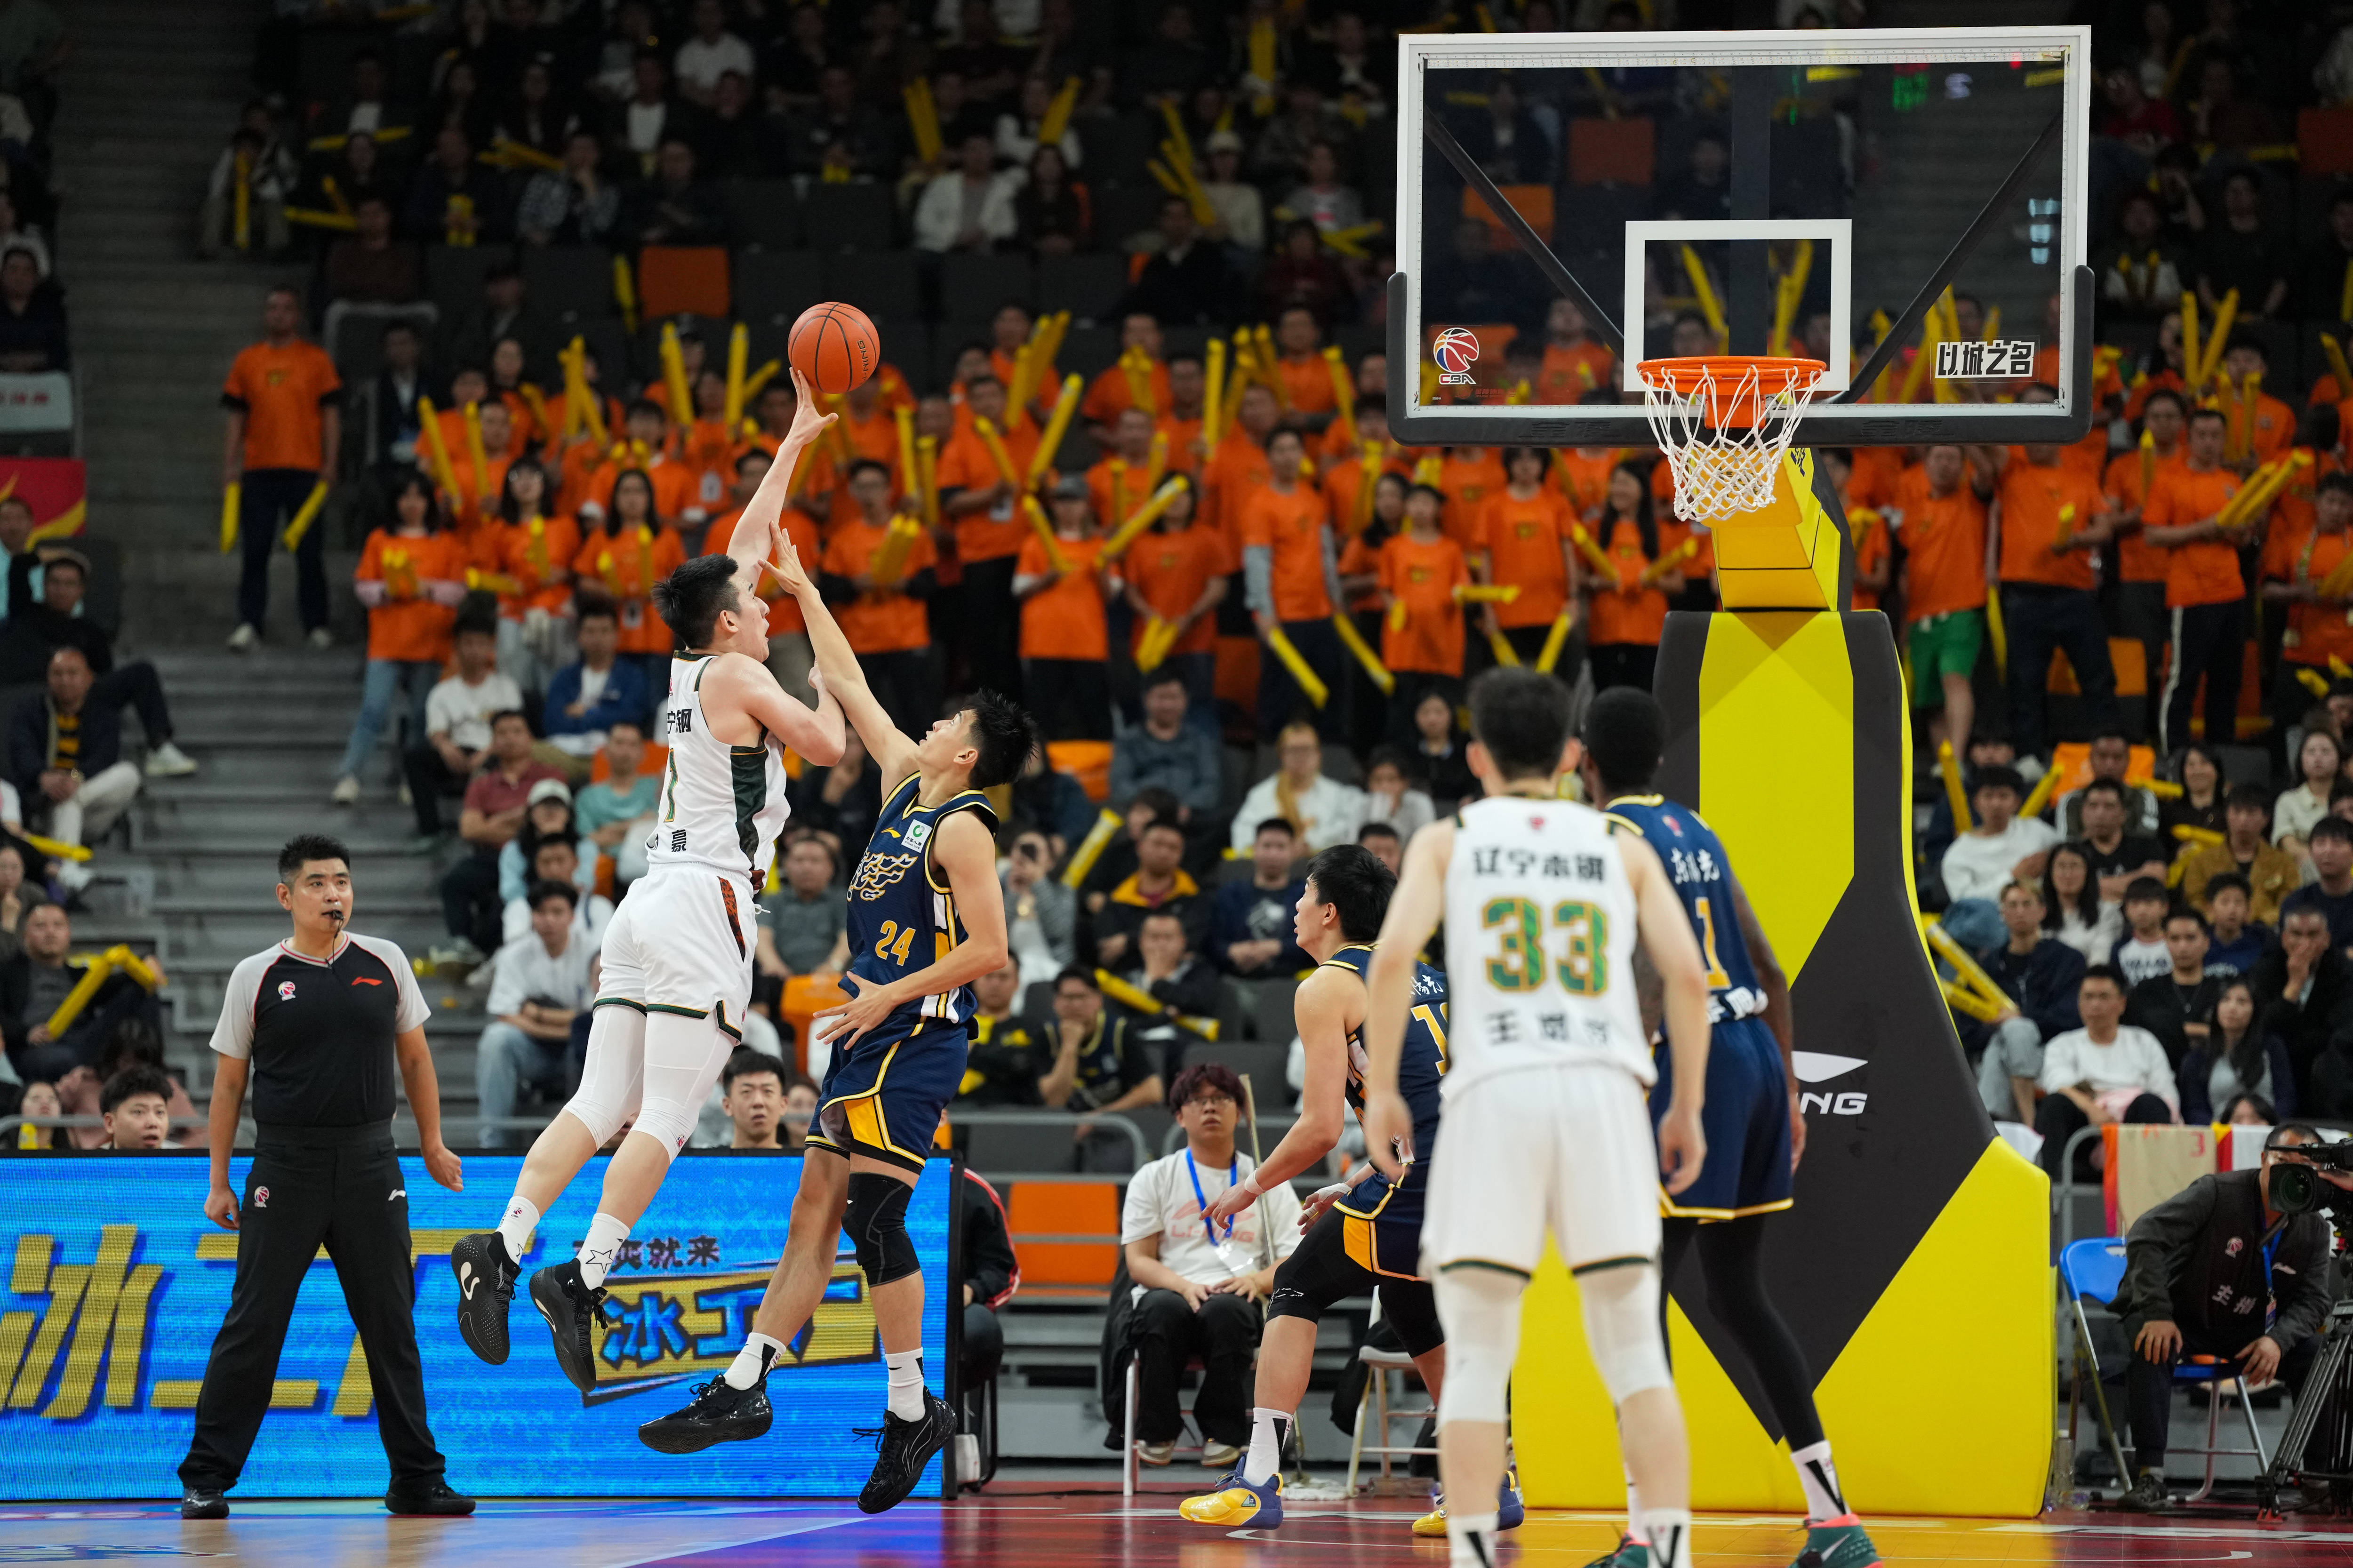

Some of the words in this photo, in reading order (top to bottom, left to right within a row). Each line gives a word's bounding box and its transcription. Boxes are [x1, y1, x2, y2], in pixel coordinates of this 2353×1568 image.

[857, 340, 869, 380] I-NING
[1937, 342, 2033, 376] 以城之名
[1439, 374, 1476, 384] CBA
[667, 708, 692, 734] 宁钢
[663, 747, 678, 823] 1
[906, 836, 922, 847] 中国人寿
[1473, 846, 1605, 882] 辽宁本钢
[875, 920, 916, 967] 24
[1482, 896, 1608, 997] 33
[1410, 1002, 1448, 1077] 1
[1796, 1092, 1868, 1115] NG
[1171, 1225, 1254, 1242] LI-NING
